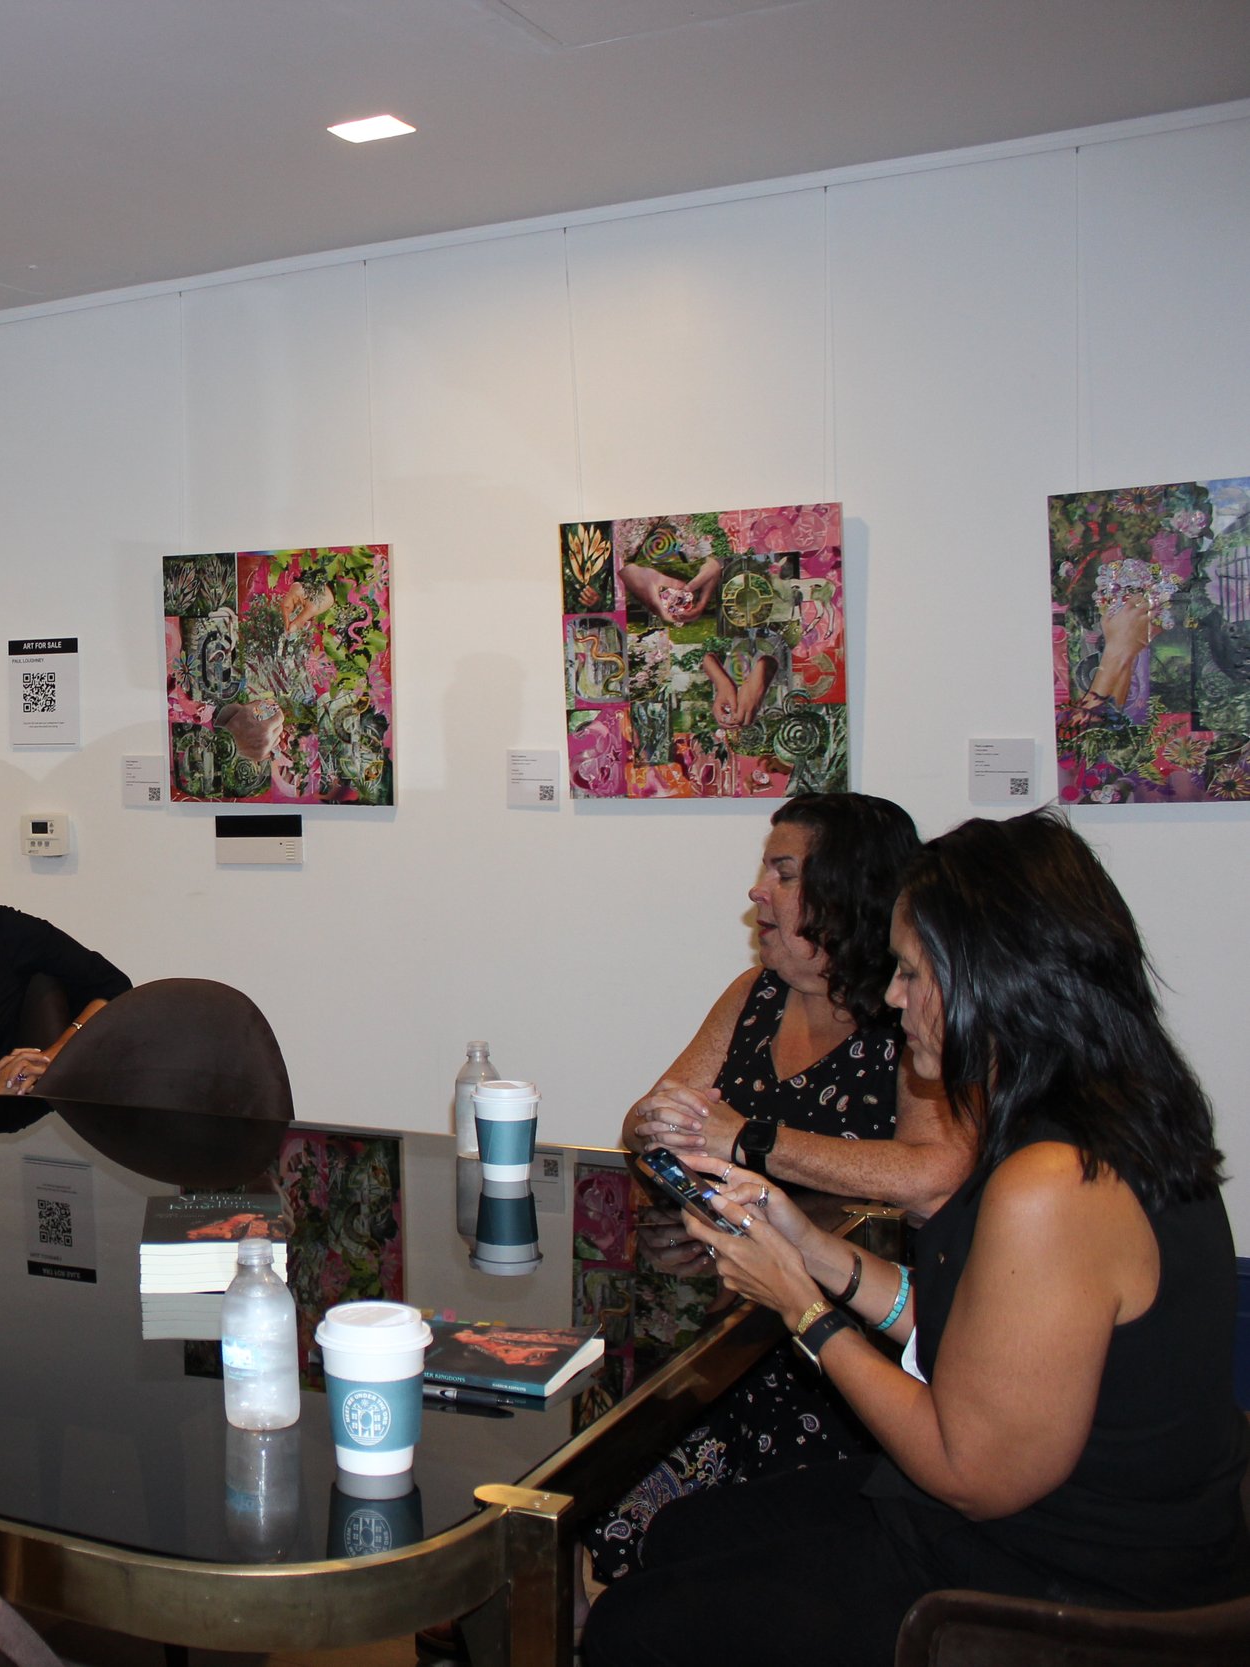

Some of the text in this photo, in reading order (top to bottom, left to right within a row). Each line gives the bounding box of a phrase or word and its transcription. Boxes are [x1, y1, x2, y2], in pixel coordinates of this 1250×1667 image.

[23, 641, 62, 650] ART FOR SALE
[434, 1373, 466, 1383] KINGDOMS
[354, 1392, 378, 1402] UNDER
[376, 1399, 387, 1411] THE
